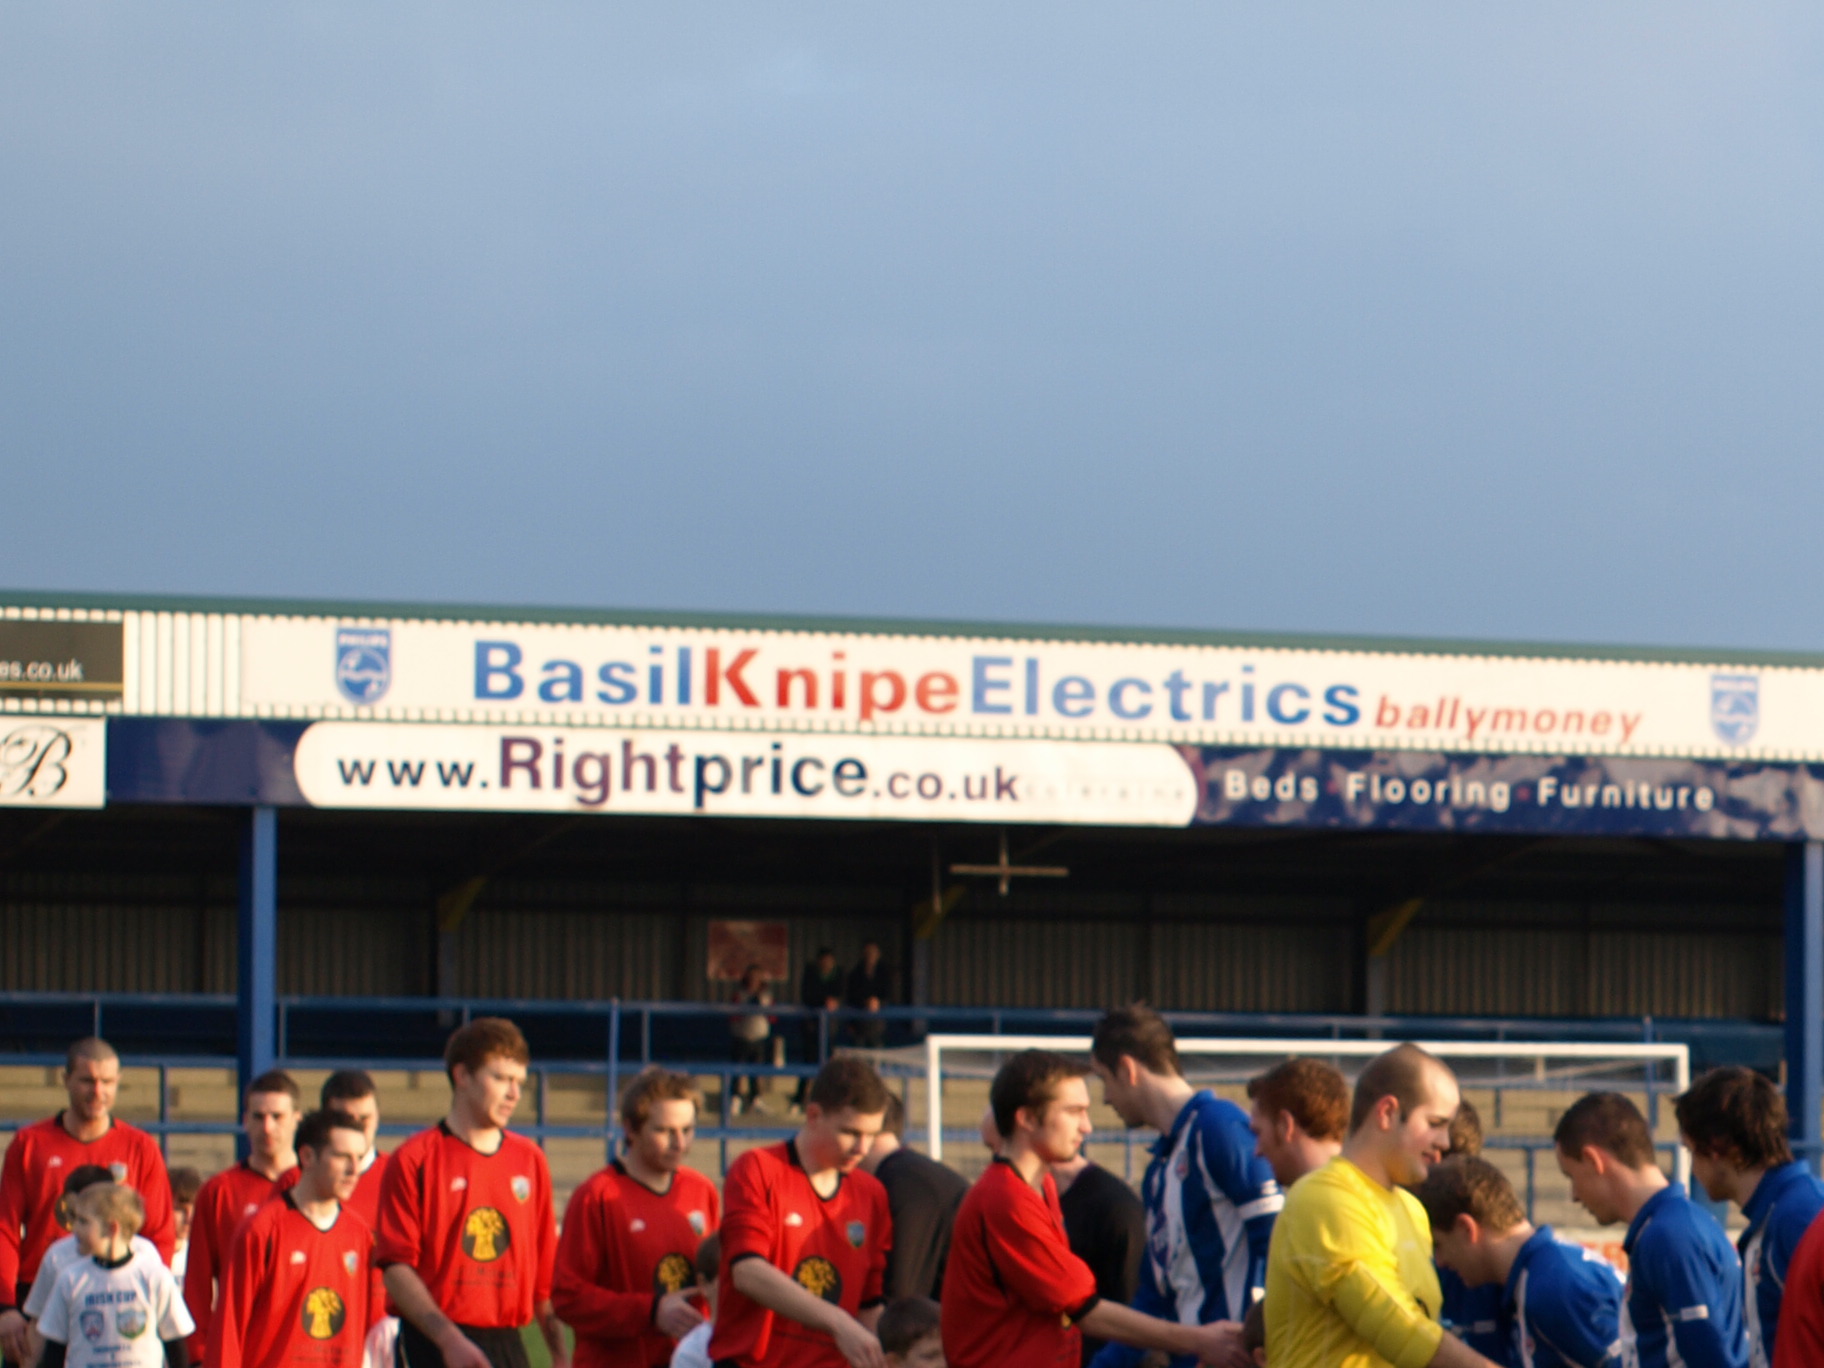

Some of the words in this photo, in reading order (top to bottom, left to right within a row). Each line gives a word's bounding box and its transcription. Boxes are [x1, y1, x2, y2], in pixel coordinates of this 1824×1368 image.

[1374, 694, 1644, 741] ballymoney
[338, 736, 1020, 810] www.Rightprice.co.uk
[1224, 769, 1319, 802] Beds
[1346, 770, 1511, 812] Flooring
[1537, 776, 1715, 811] Furniture
